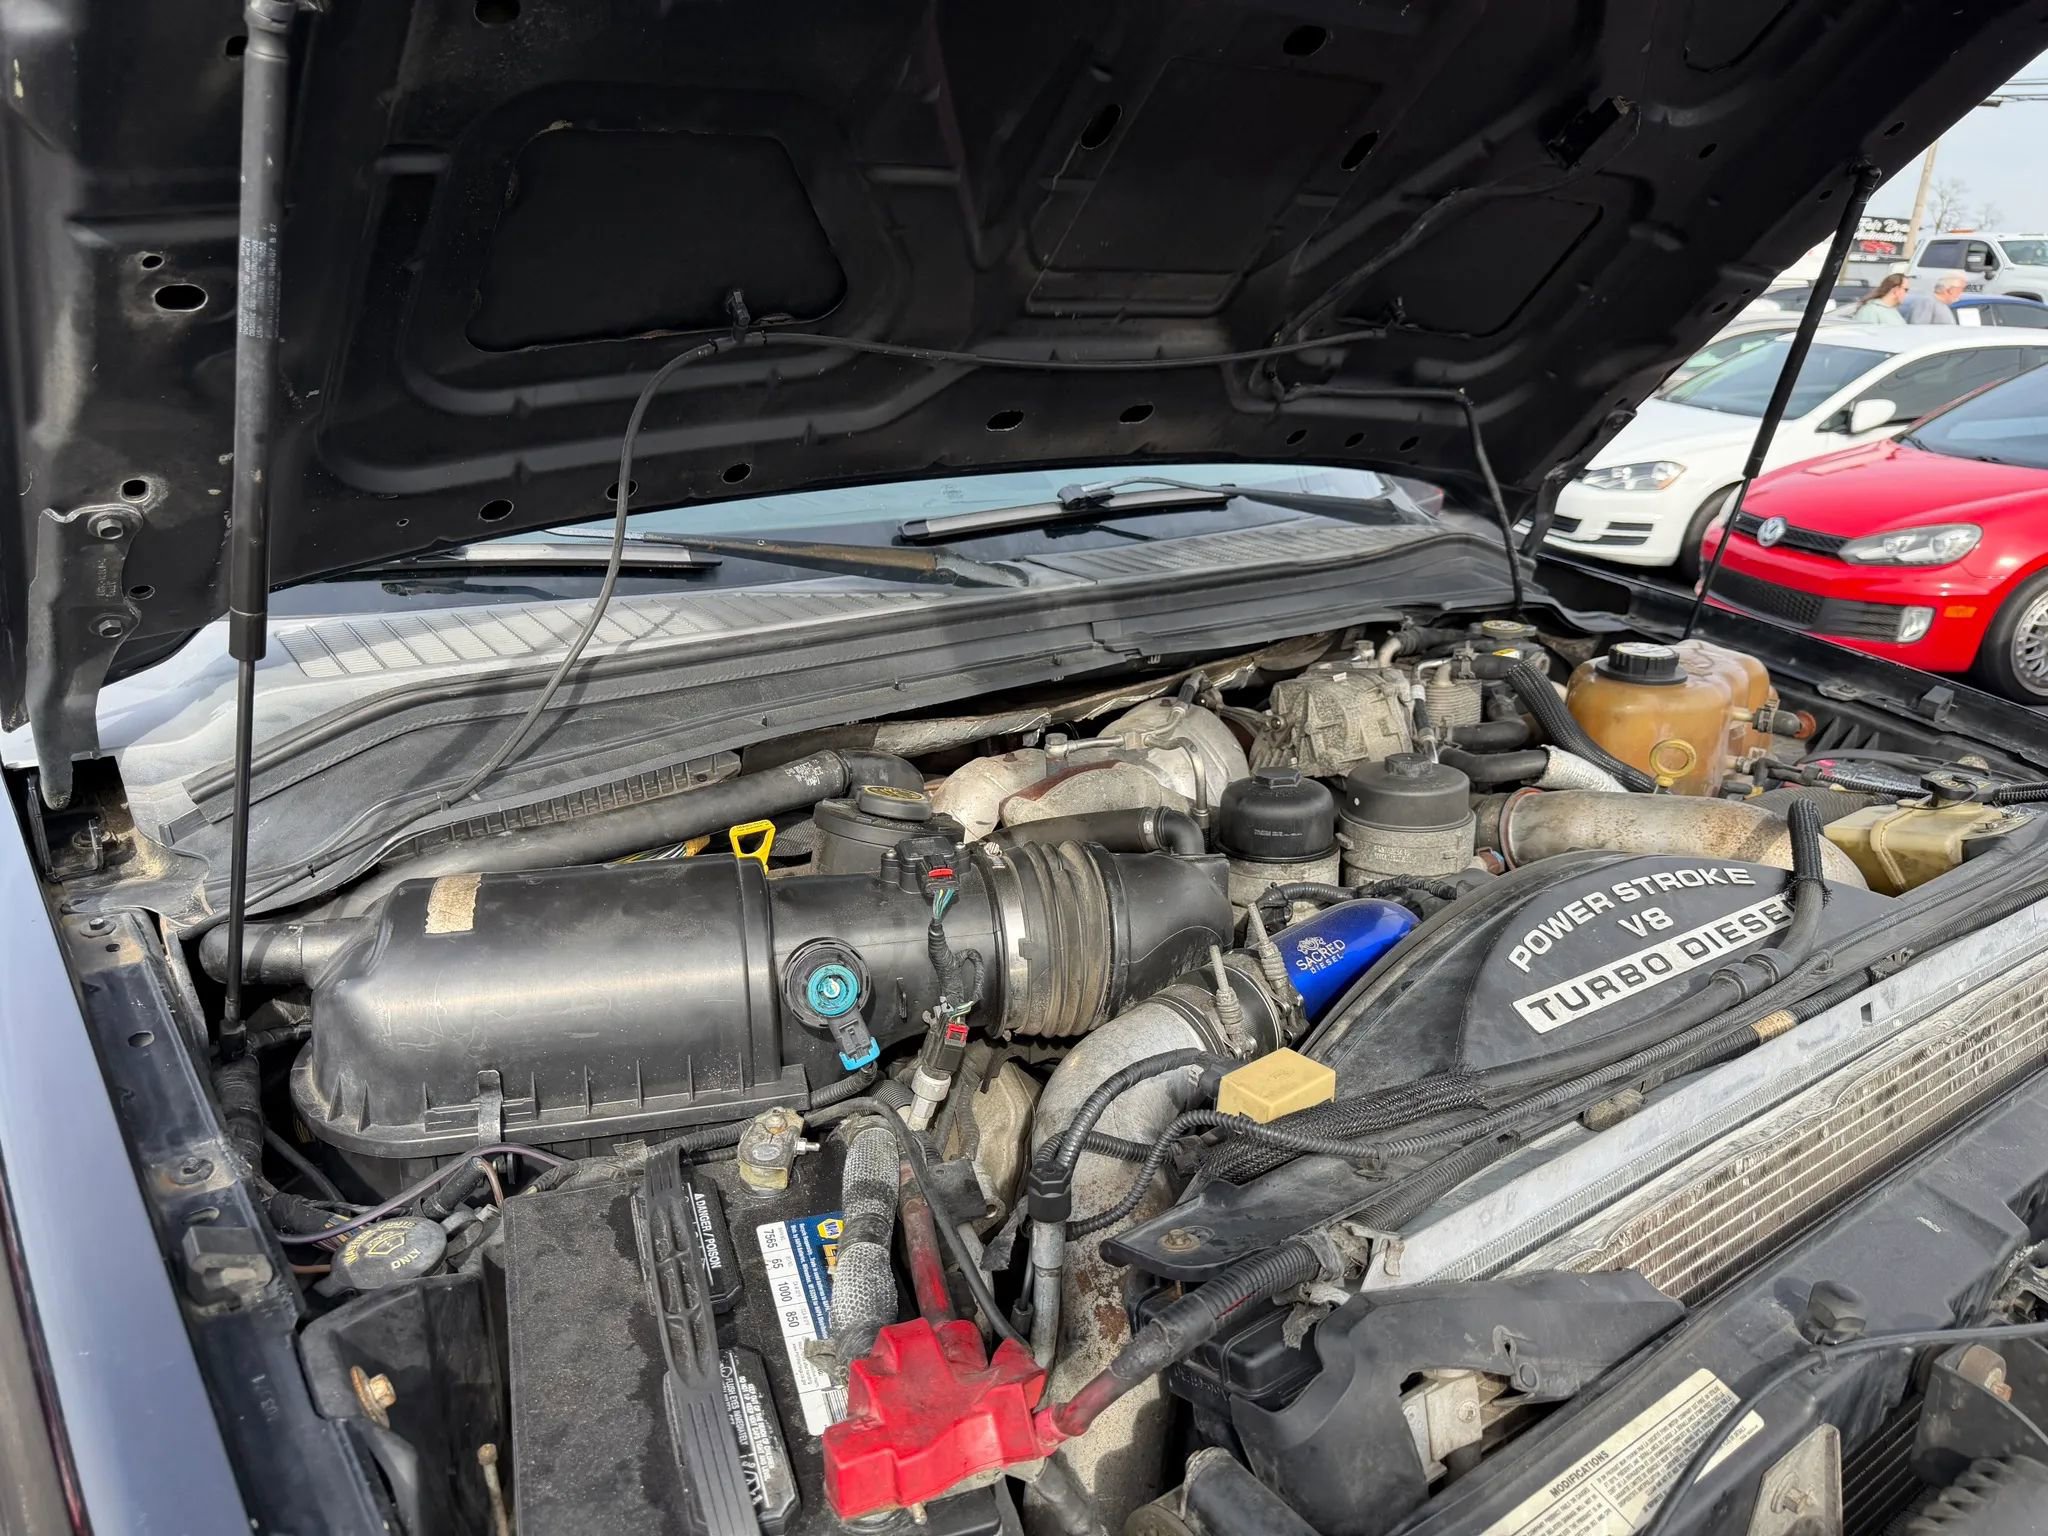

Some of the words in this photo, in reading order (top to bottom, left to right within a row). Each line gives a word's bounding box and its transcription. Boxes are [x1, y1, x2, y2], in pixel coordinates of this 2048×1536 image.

[1507, 891, 1616, 973] POWER
[1611, 867, 1756, 903] STROKE
[1617, 907, 1674, 938] V8
[1295, 939, 1346, 971] SACRED
[1310, 953, 1344, 975] DIESEL
[1526, 952, 1673, 1022] TURBO
[694, 1200, 711, 1231] DANGER
[703, 1237, 722, 1269] POISON
[763, 1229, 778, 1249] 7565
[391, 1248, 421, 1270] ONLY
[771, 1258, 783, 1269] 65
[777, 1281, 792, 1302] 1000
[785, 1311, 799, 1328] 850
[725, 1377, 736, 1395] FLUSH
[729, 1394, 740, 1409] EYES
[1549, 1450, 1610, 1498] MODIFICATIONS
